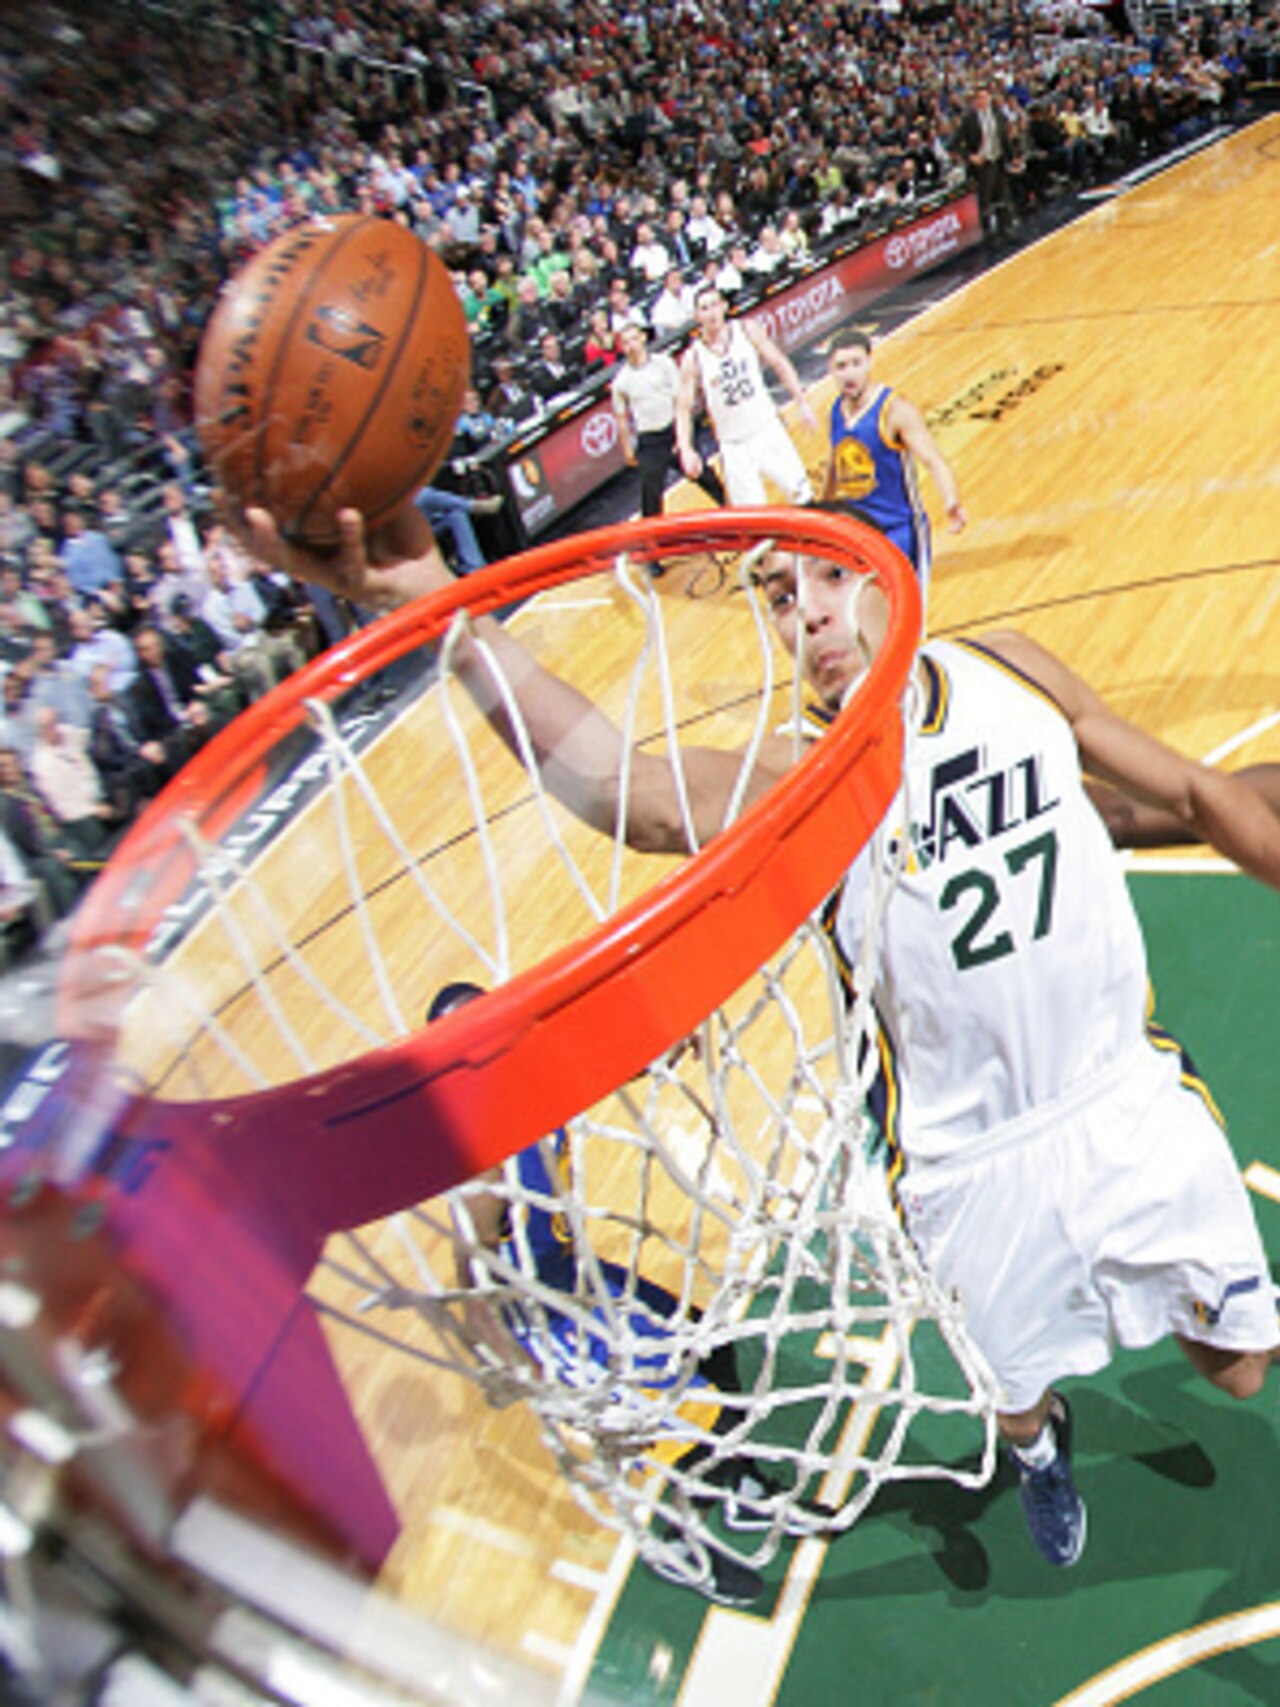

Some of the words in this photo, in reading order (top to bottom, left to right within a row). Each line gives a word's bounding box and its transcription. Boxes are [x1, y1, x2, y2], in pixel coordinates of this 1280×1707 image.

[775, 275, 845, 328] TOYOTA
[722, 379, 755, 406] 20
[913, 745, 1061, 866] JAZZ
[938, 827, 1060, 973] 27
